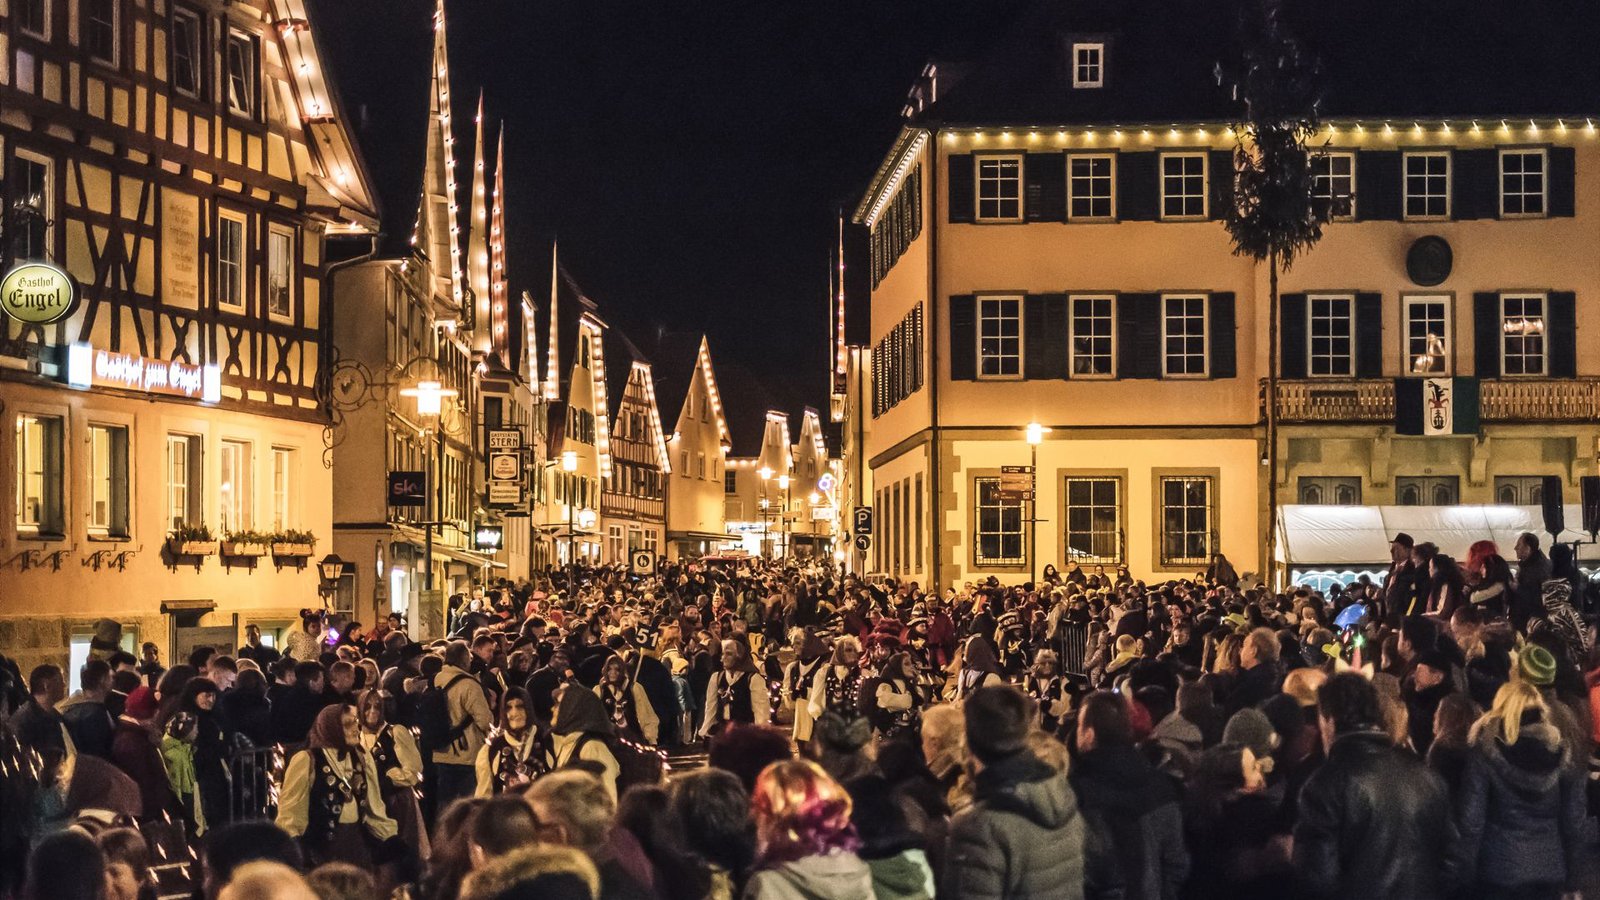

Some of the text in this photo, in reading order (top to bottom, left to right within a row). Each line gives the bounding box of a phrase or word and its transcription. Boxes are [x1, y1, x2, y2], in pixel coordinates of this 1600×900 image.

[18, 276, 54, 288] Gasthof
[9, 288, 62, 311] Engel
[490, 438, 518, 447] STERN
[858, 513, 868, 525] P
[636, 628, 659, 647] 51
